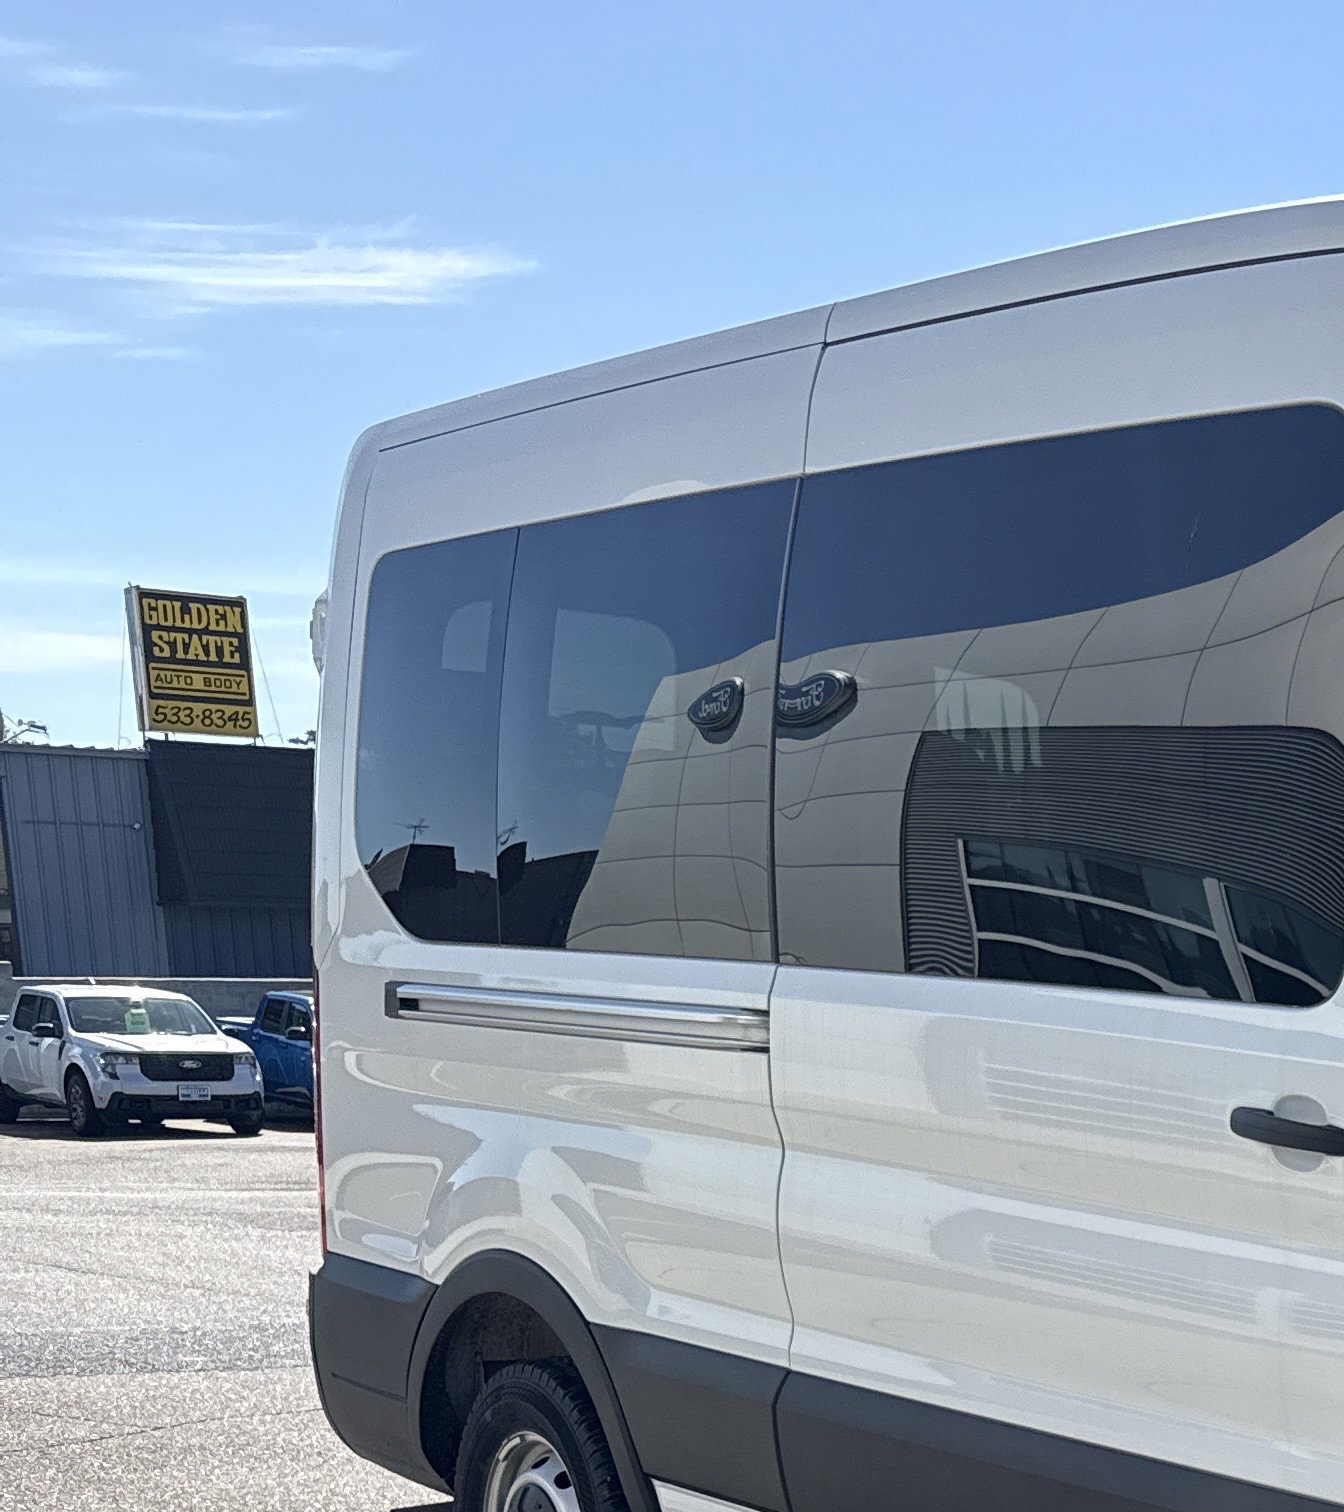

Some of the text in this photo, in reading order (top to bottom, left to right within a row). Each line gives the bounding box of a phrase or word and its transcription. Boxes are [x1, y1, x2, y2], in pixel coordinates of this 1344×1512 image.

[142, 598, 244, 633] GOLDEN
[151, 630, 241, 664] STATE
[154, 672, 243, 690] AUTO BODY
